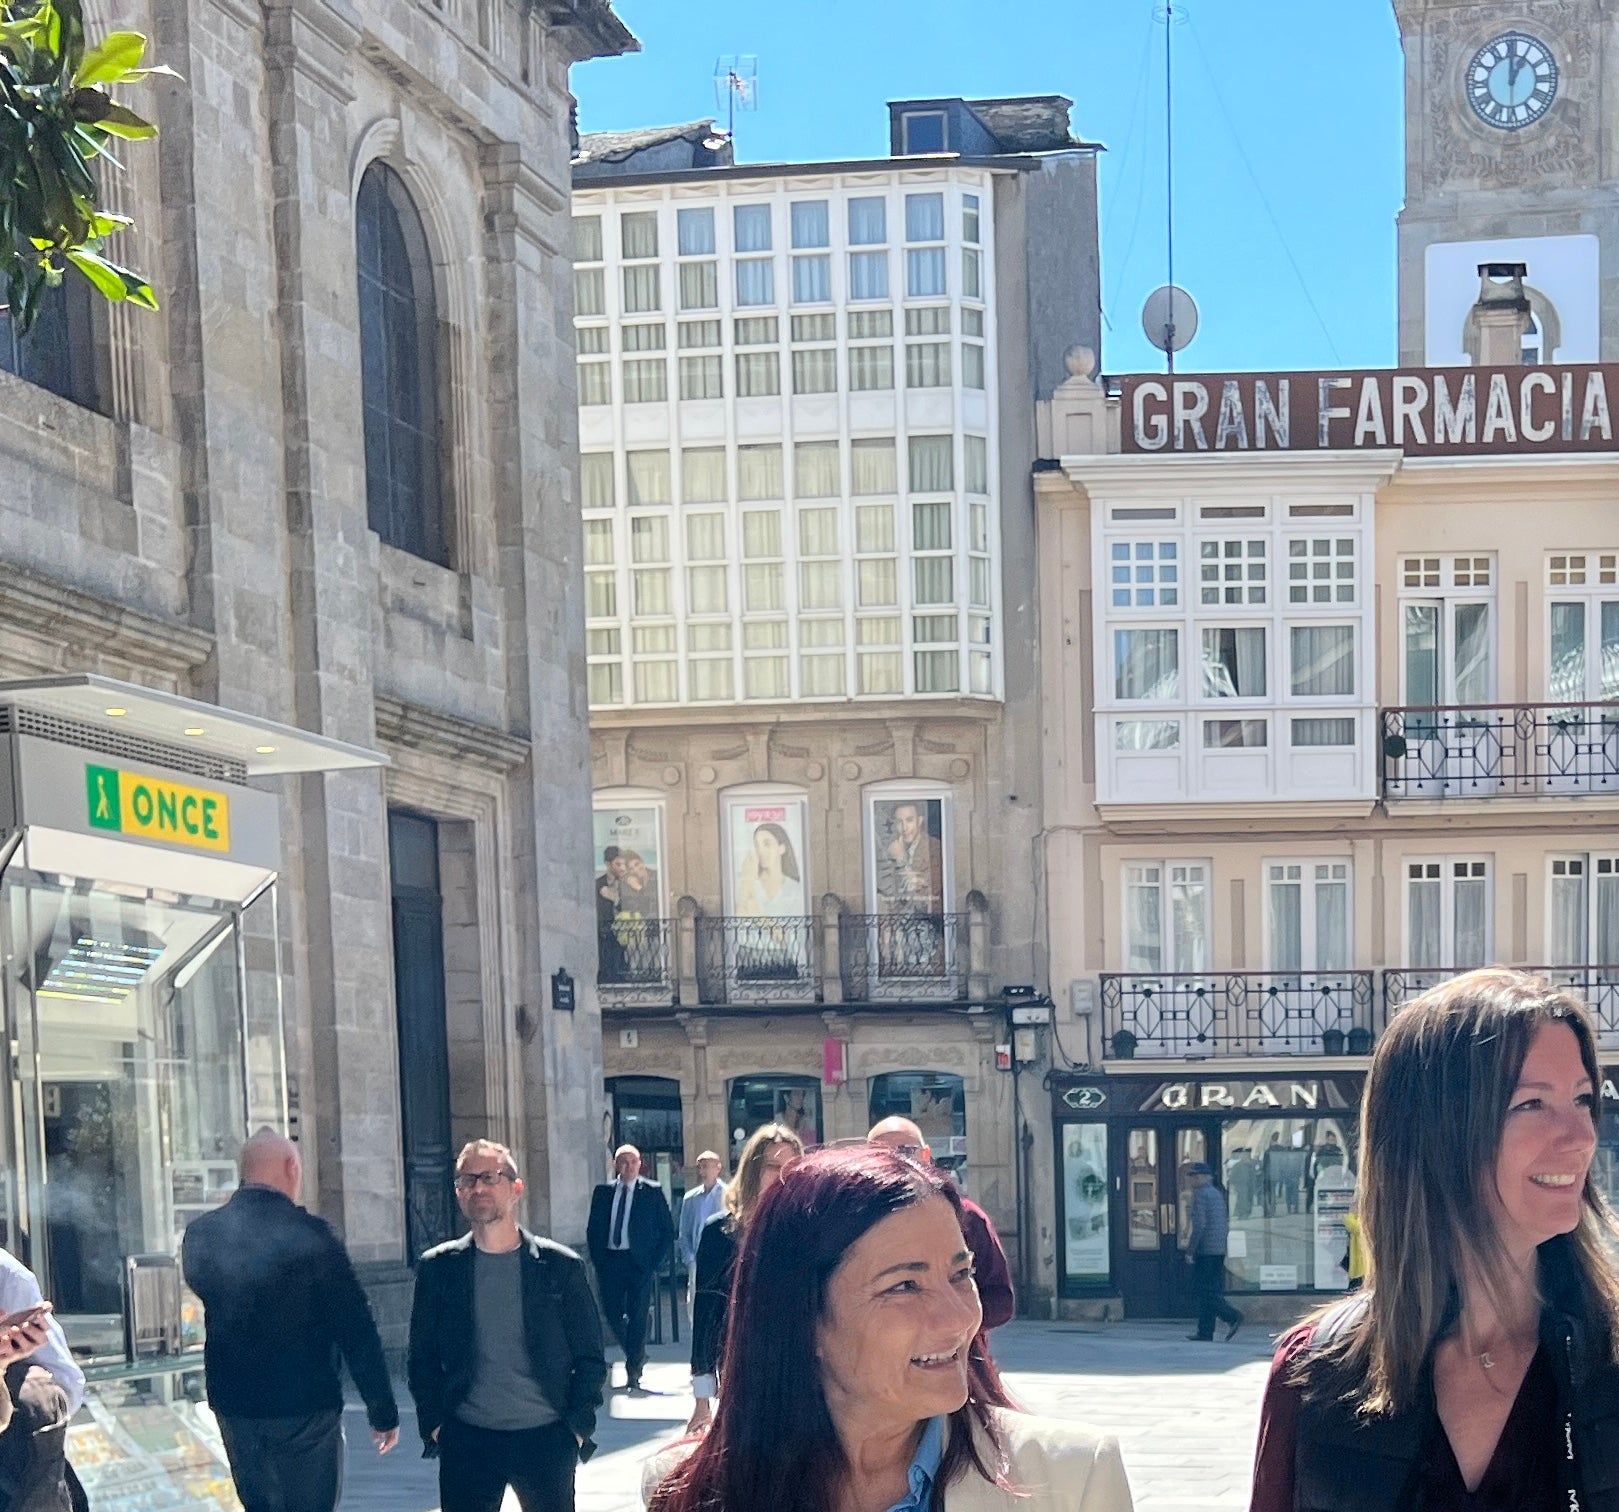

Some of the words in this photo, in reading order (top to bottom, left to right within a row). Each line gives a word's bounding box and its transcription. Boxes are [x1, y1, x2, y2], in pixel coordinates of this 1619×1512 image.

[1132, 379, 1290, 451] GRAN
[1317, 371, 1613, 448] FARMACIA
[132, 784, 220, 840] ONCE
[1079, 1091, 1092, 1105] 2
[1161, 1084, 1318, 1109] GRAN
